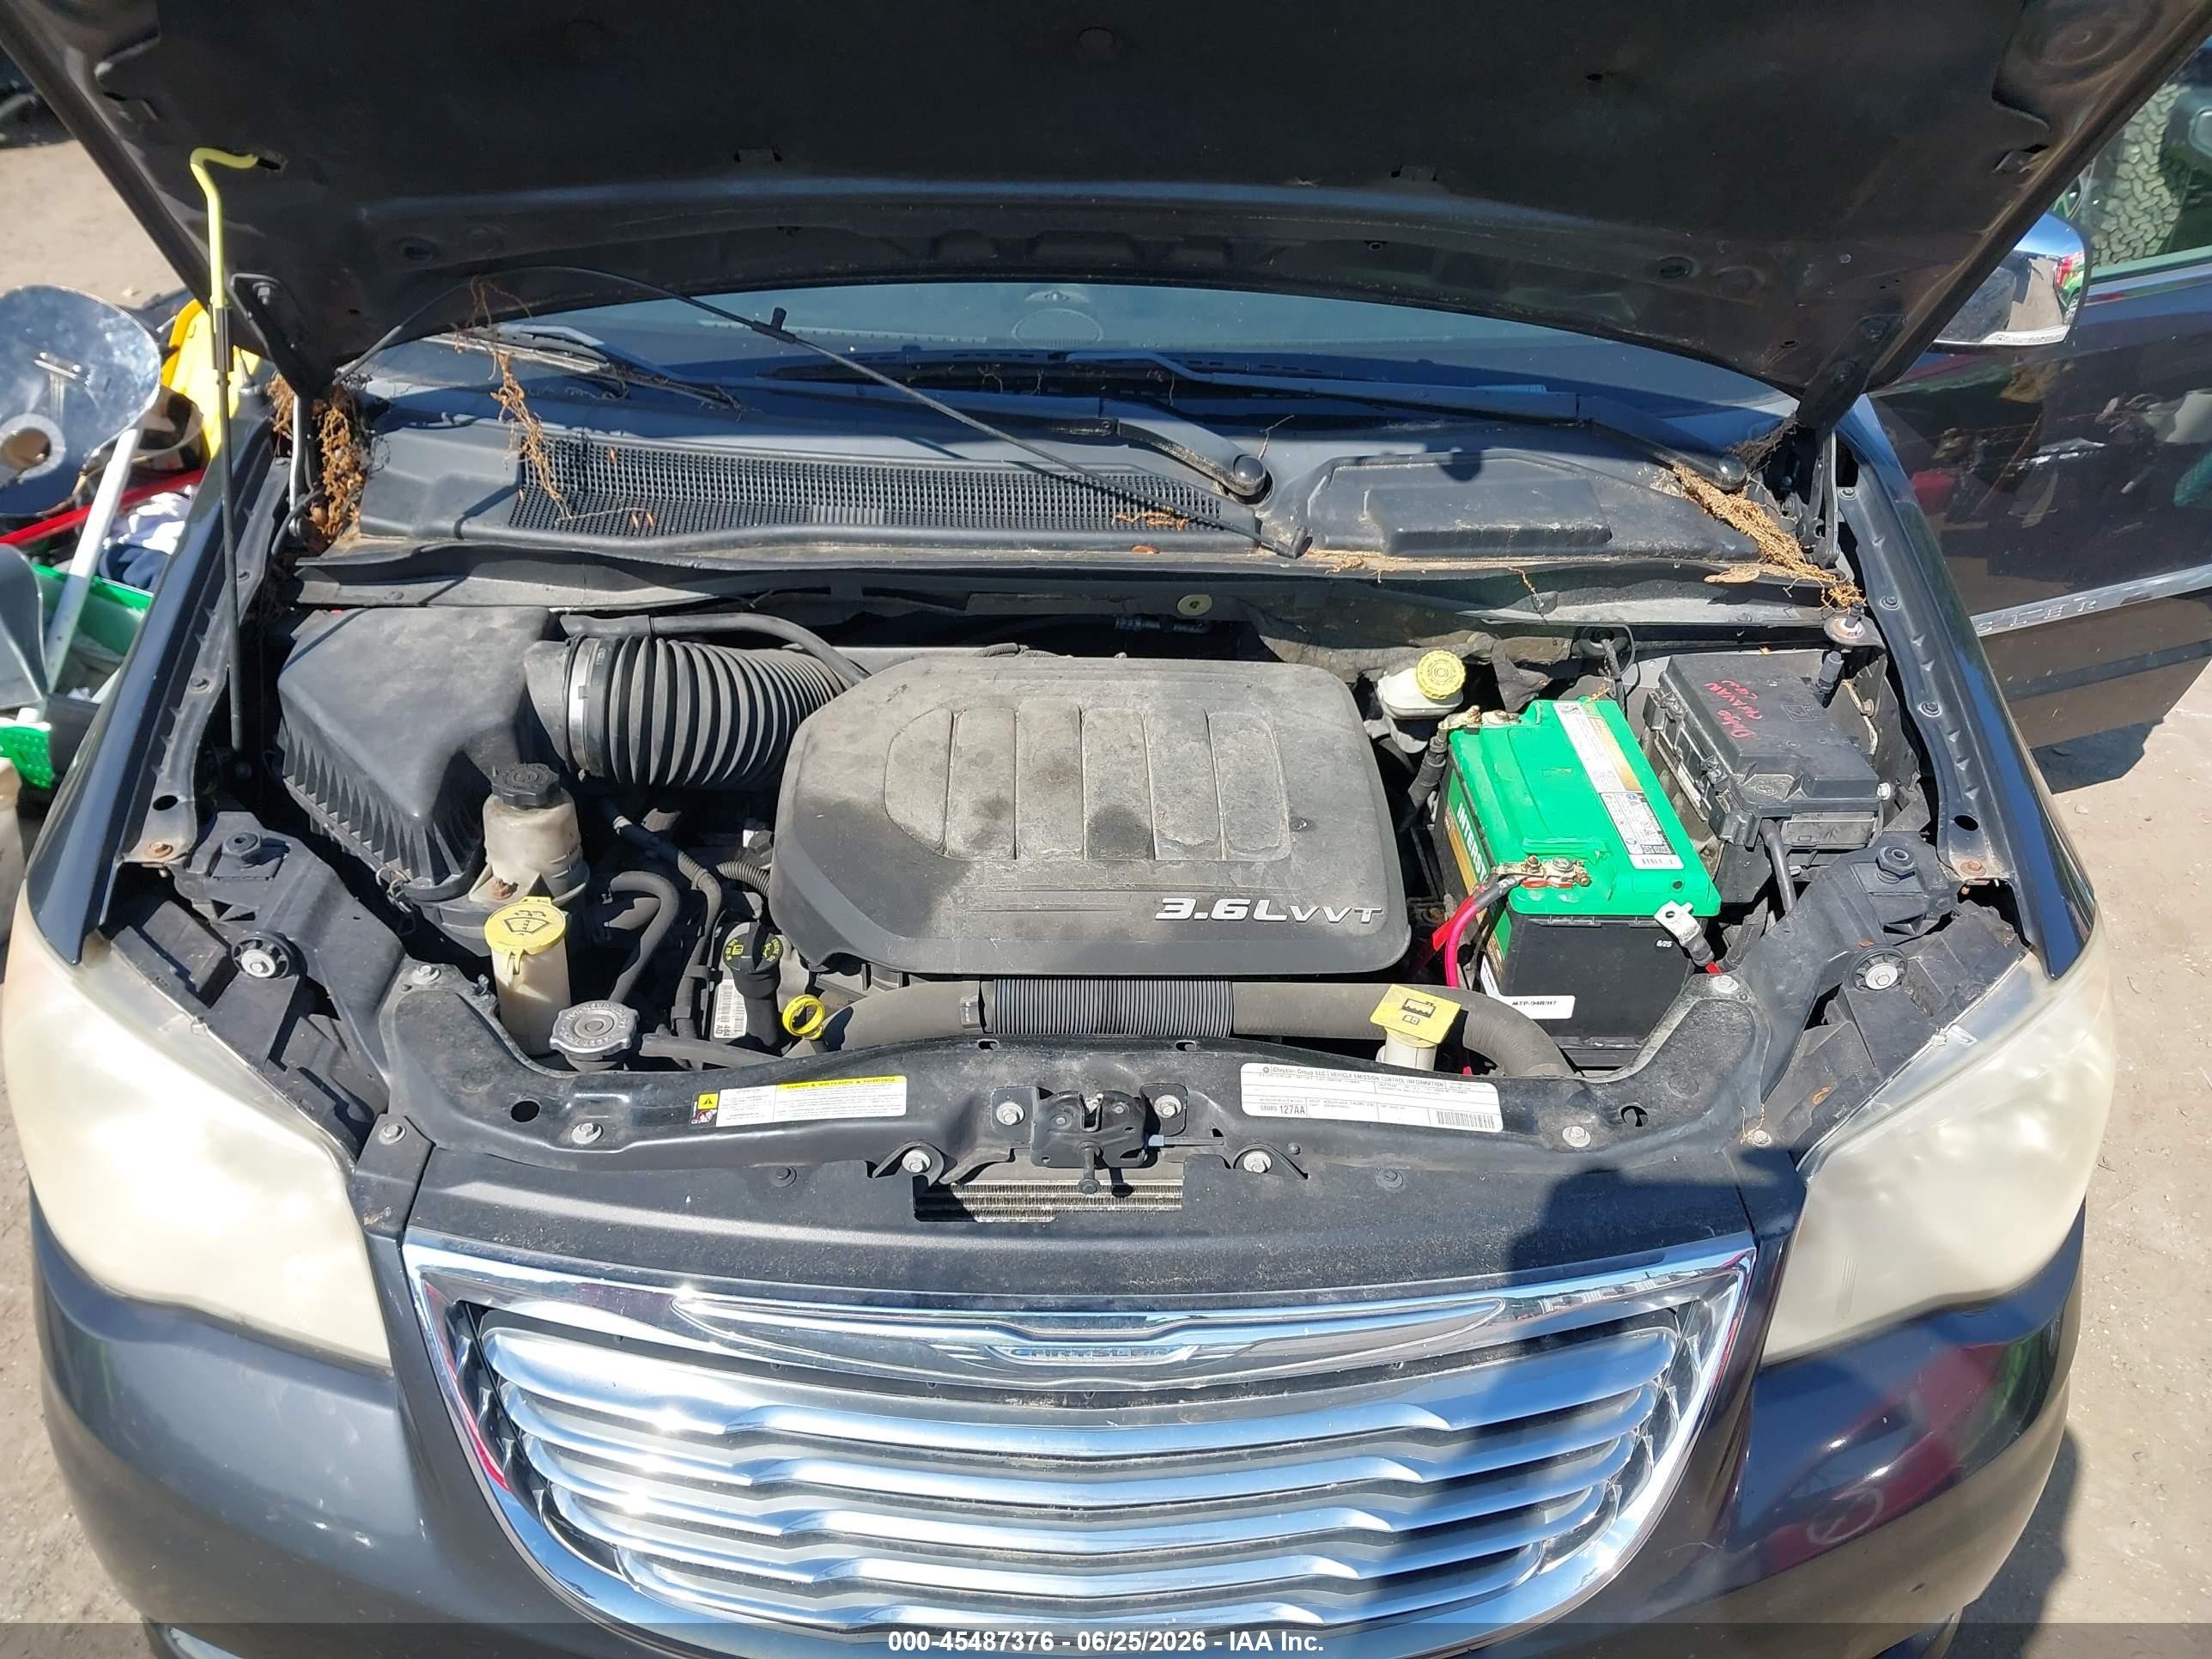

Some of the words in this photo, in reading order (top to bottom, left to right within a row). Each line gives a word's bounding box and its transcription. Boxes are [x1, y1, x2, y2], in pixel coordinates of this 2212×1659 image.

[1977, 597, 2098, 632] SLER
[1456, 802, 1488, 884] INTERST
[1279, 1105, 1305, 1115] 127AA
